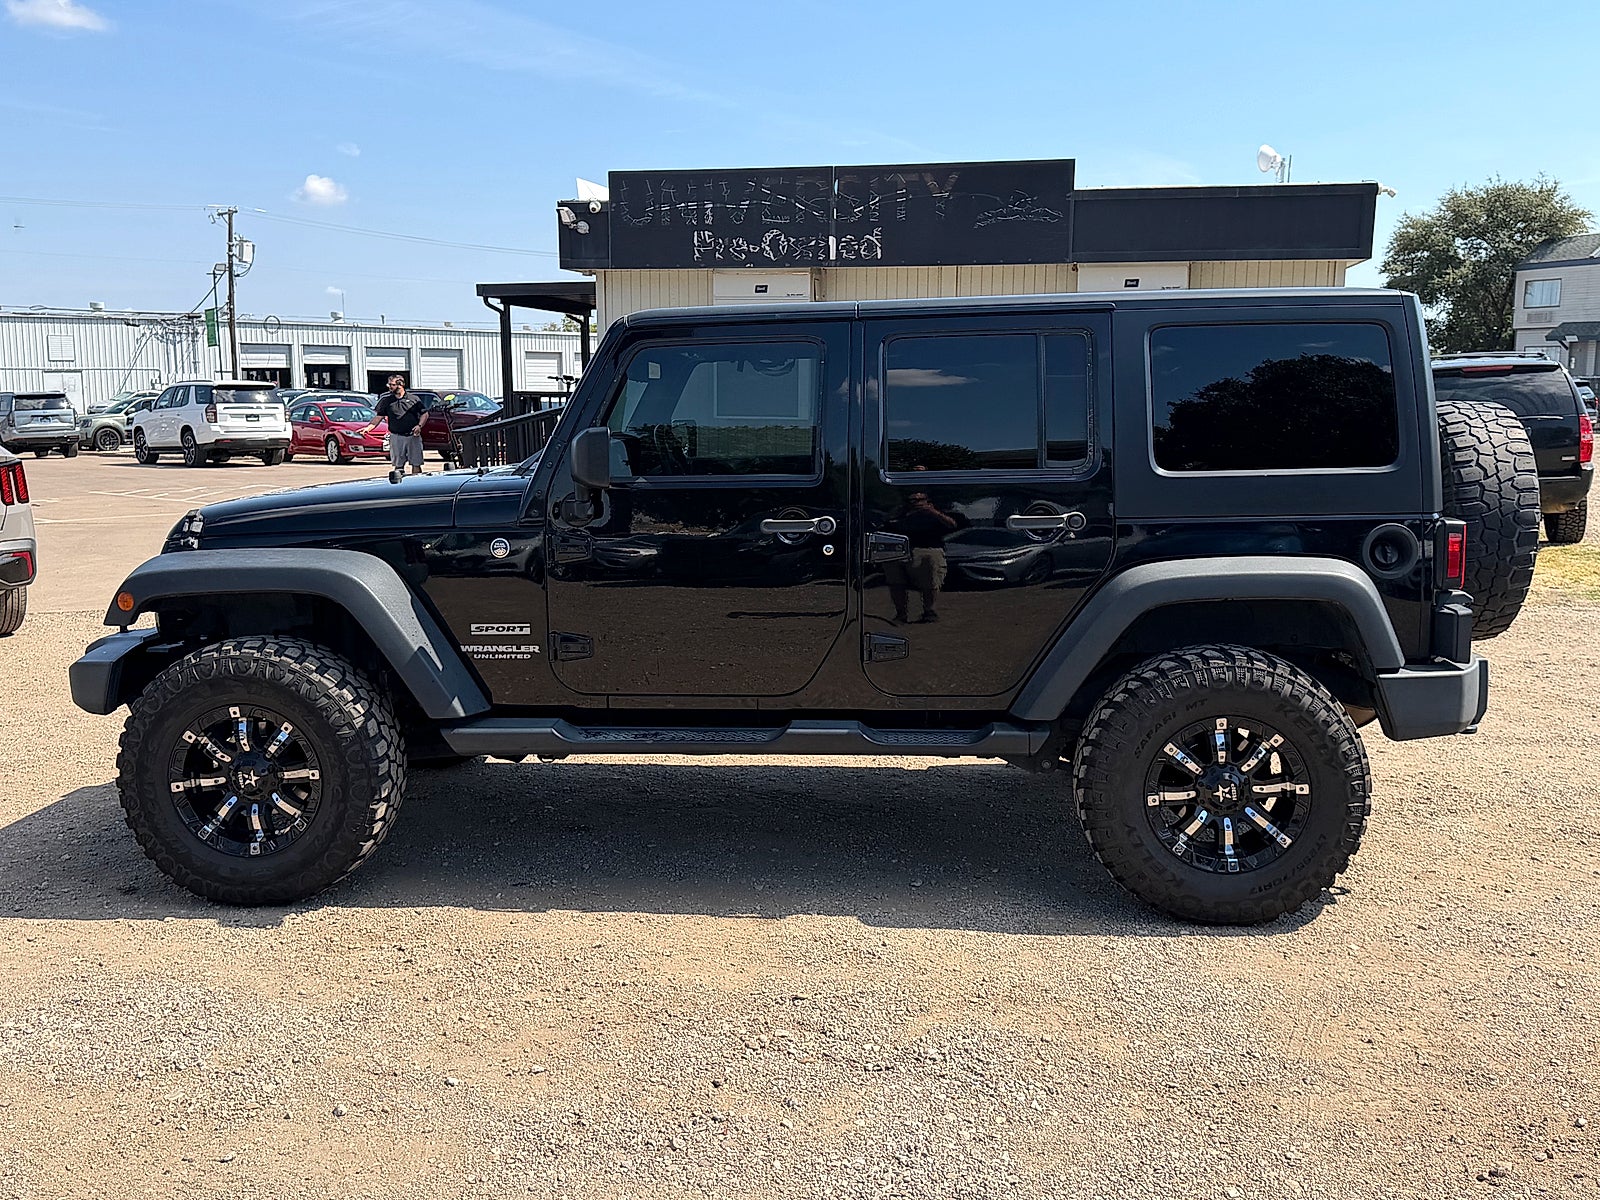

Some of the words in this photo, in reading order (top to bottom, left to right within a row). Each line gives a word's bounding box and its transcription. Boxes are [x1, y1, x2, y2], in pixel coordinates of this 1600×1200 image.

[473, 625, 530, 634] SPORT
[460, 645, 540, 653] WRANGLER
[1134, 711, 1177, 759] SAFARI
